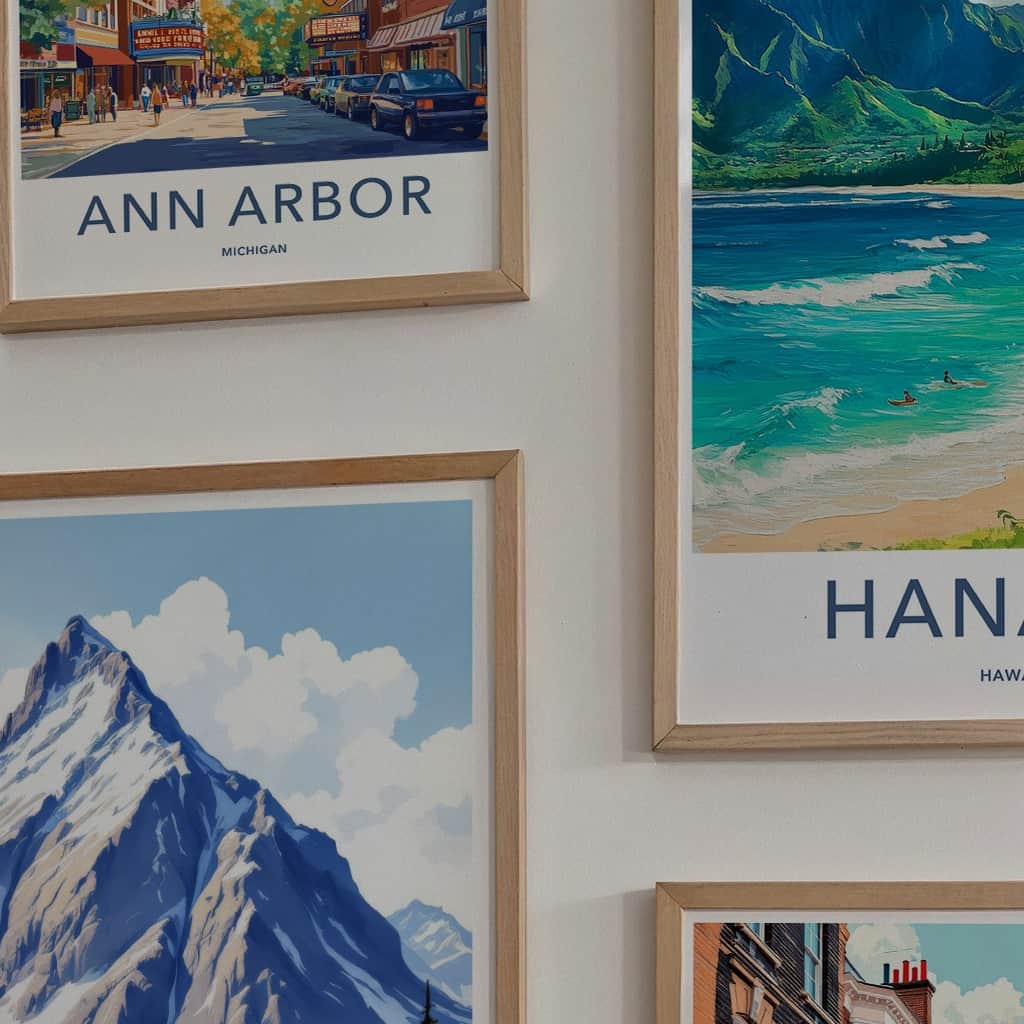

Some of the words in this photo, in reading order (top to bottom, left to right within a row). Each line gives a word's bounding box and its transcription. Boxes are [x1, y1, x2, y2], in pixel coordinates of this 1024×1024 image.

[76, 188, 204, 236] ANN
[228, 175, 432, 227] ARBOR
[221, 243, 288, 257] MICHIGAN
[826, 577, 1024, 640] HAN
[980, 668, 1024, 682] HAW
